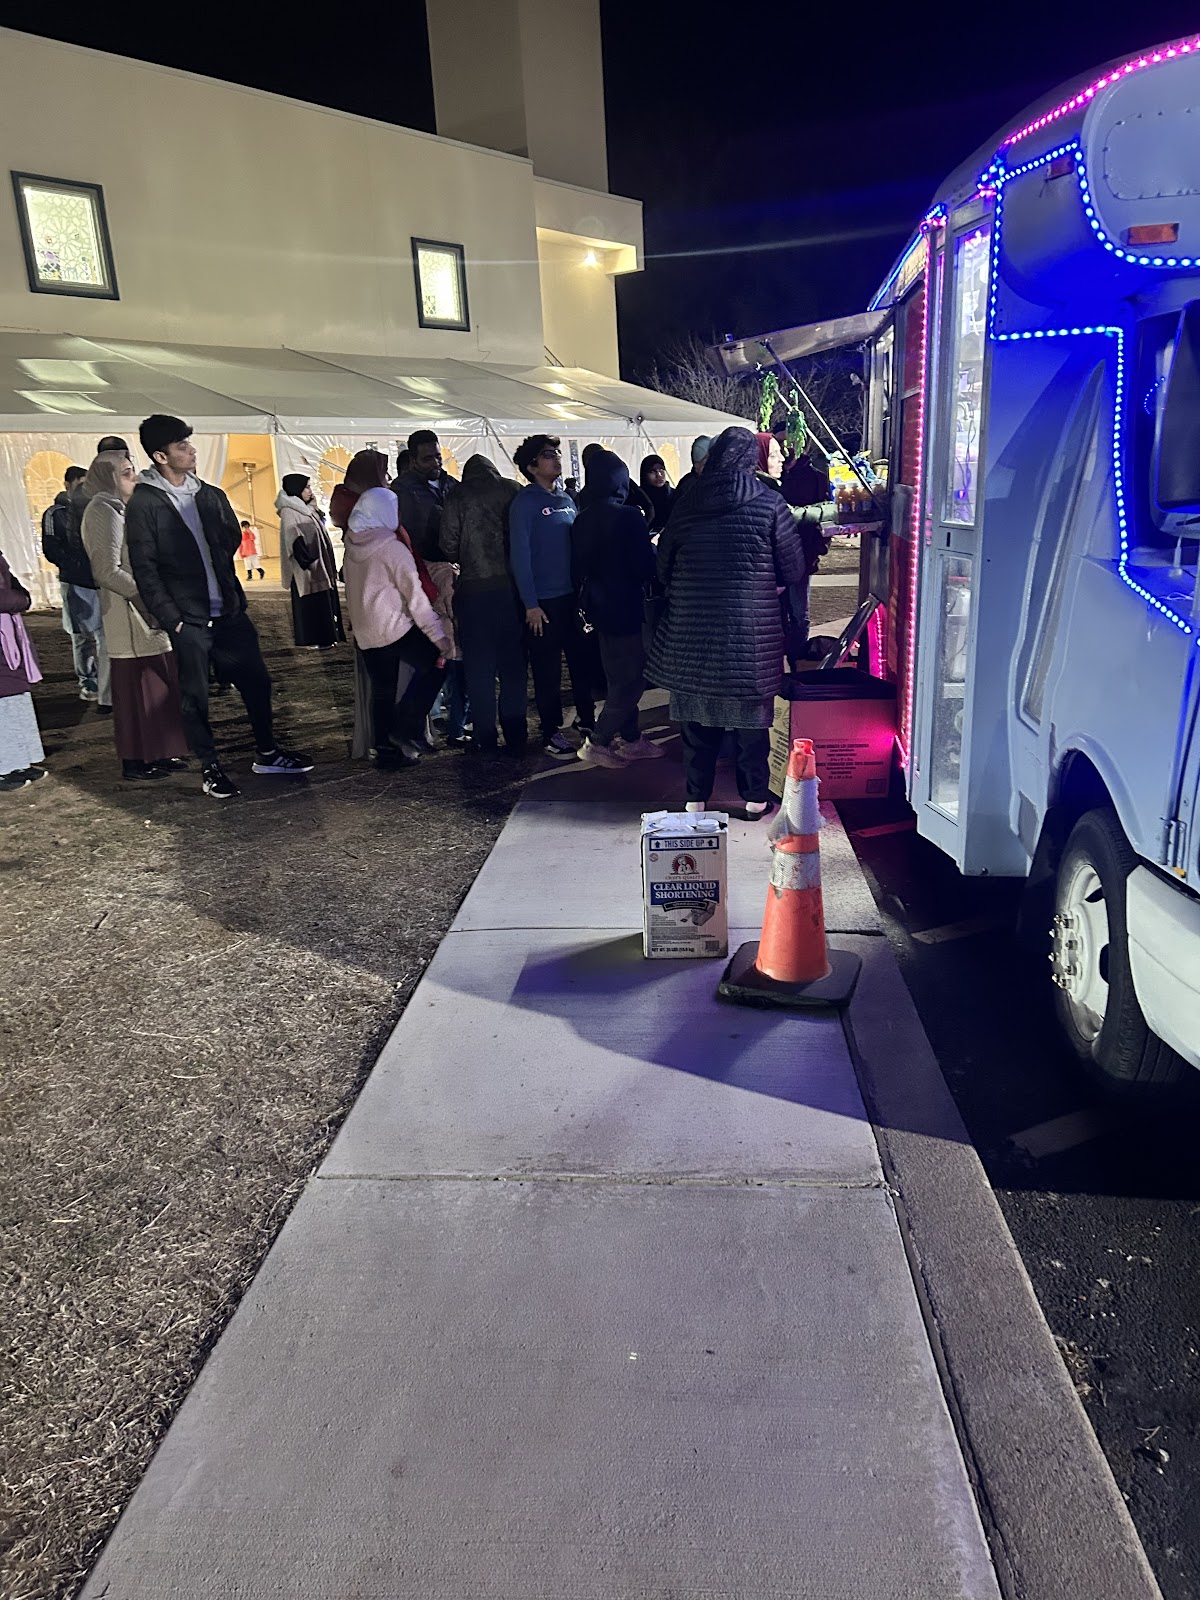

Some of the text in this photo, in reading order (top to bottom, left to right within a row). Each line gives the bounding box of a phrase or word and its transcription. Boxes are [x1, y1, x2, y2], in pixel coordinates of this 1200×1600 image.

[664, 839, 705, 848] THIS SIDE UP
[653, 882, 717, 891] CLEAR LIQUID
[655, 890, 715, 899] SHORTENING
